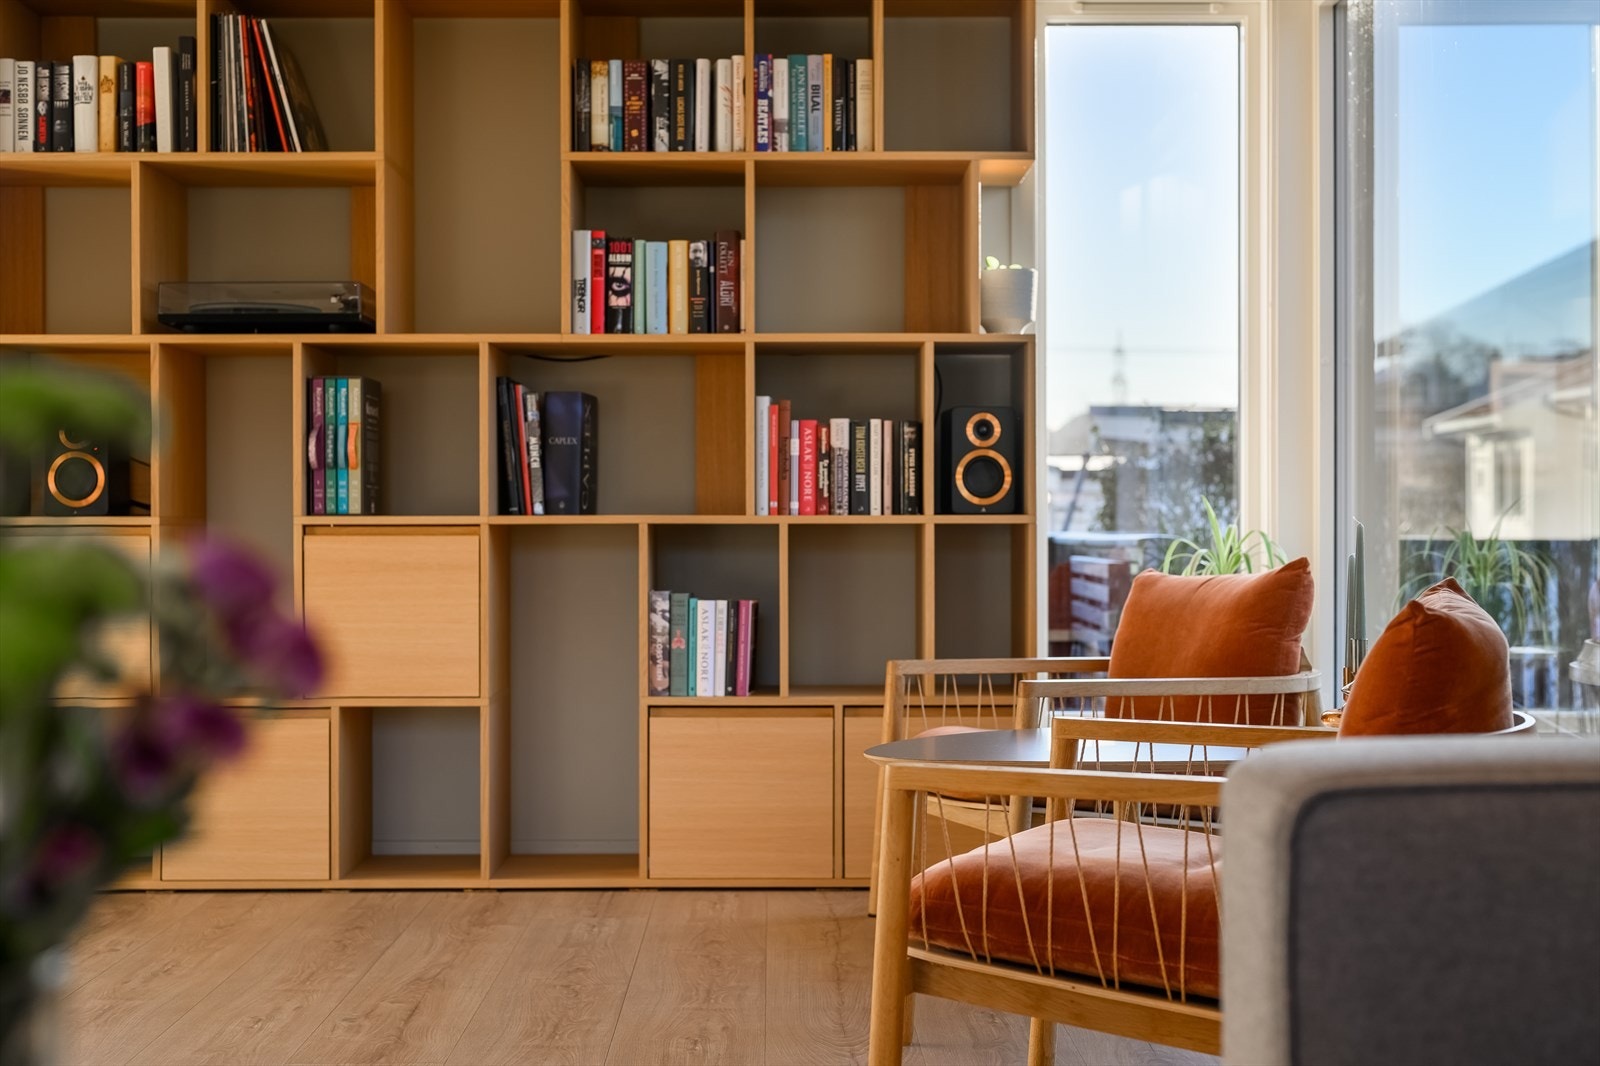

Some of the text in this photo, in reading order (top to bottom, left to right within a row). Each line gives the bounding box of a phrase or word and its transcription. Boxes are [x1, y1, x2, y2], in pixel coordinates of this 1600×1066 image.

[17, 64, 29, 141] JO NESBØ SØNNEN
[795, 65, 806, 137] JON MICHELET
[810, 84, 821, 114] BILAL
[757, 98, 769, 144] BEATLES
[608, 241, 632, 253] 1001
[608, 253, 632, 263] ALBUM
[718, 241, 729, 275] FOLLETT
[719, 280, 735, 307] ALDRI
[529, 436, 541, 469] MUNCH
[548, 436, 578, 446] CAPLEX
[803, 427, 812, 502] ASLAK NORE
[700, 608, 710, 681] ASLAK NORE
